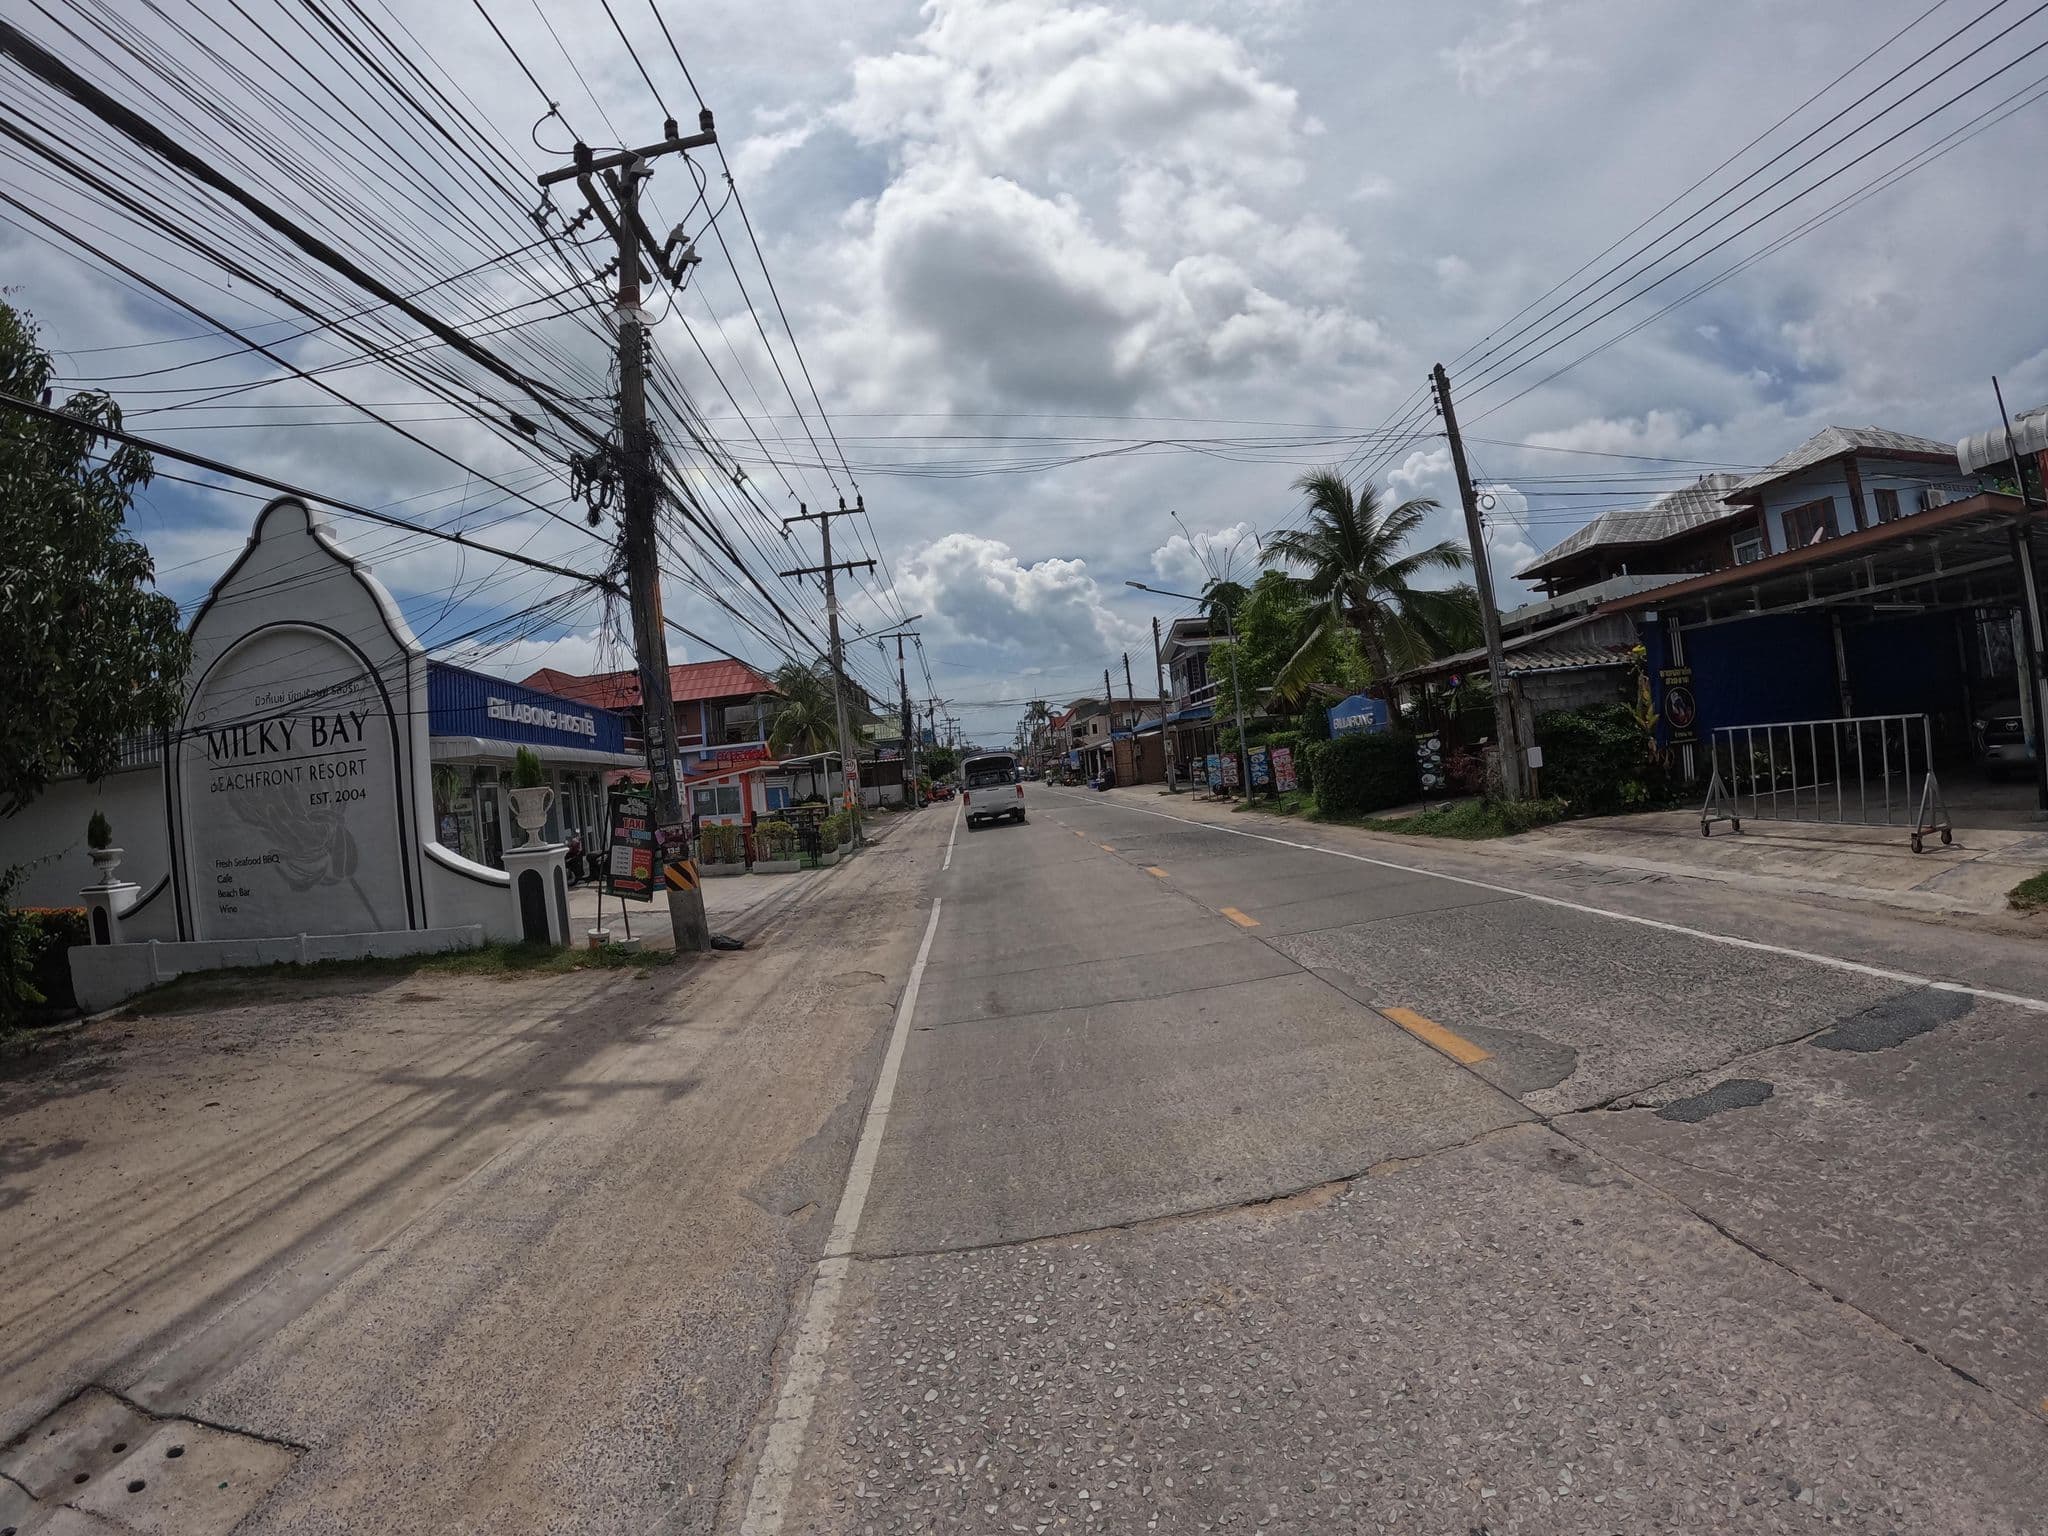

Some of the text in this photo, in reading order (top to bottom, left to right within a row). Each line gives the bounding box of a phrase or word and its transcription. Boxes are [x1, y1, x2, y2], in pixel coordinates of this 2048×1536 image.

[487, 697, 597, 736] BILLABONG HOSTEL
[207, 708, 369, 761] MILKY BAY
[210, 759, 367, 792] BEACHFRONT RESORT
[310, 788, 367, 805] EST. 2004
[215, 854, 280, 869] Fresh Seafood BBQ
[218, 887, 250, 898] Beach Bar
